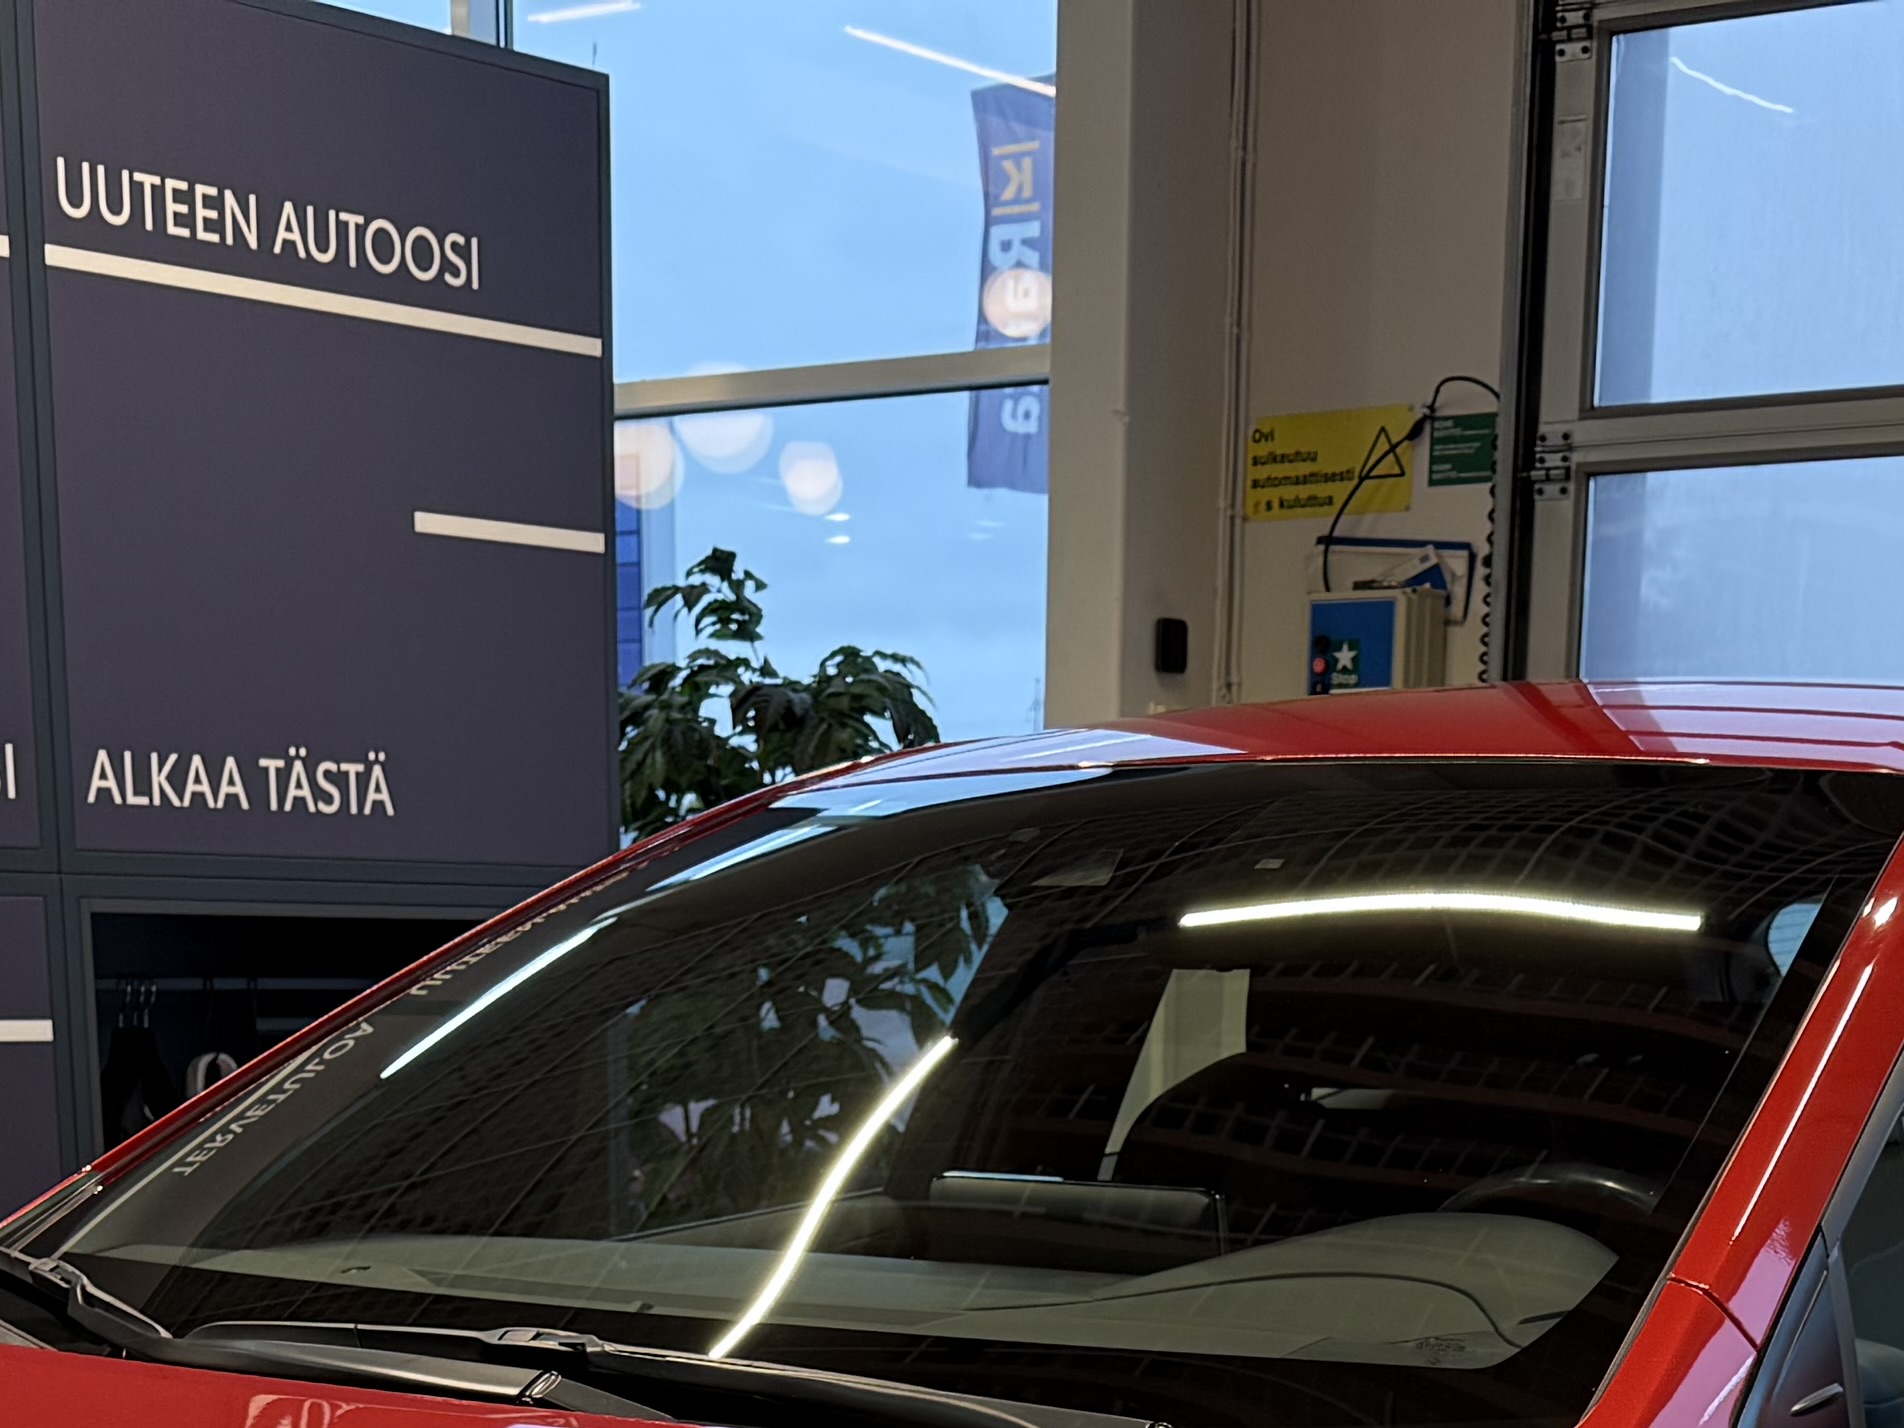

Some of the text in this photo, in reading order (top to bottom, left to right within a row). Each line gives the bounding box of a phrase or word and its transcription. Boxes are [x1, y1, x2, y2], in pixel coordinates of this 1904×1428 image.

[56, 156, 481, 291] UUTEEN AUTOOSI
[87, 746, 395, 818] ALKAA TÄSTÄ
